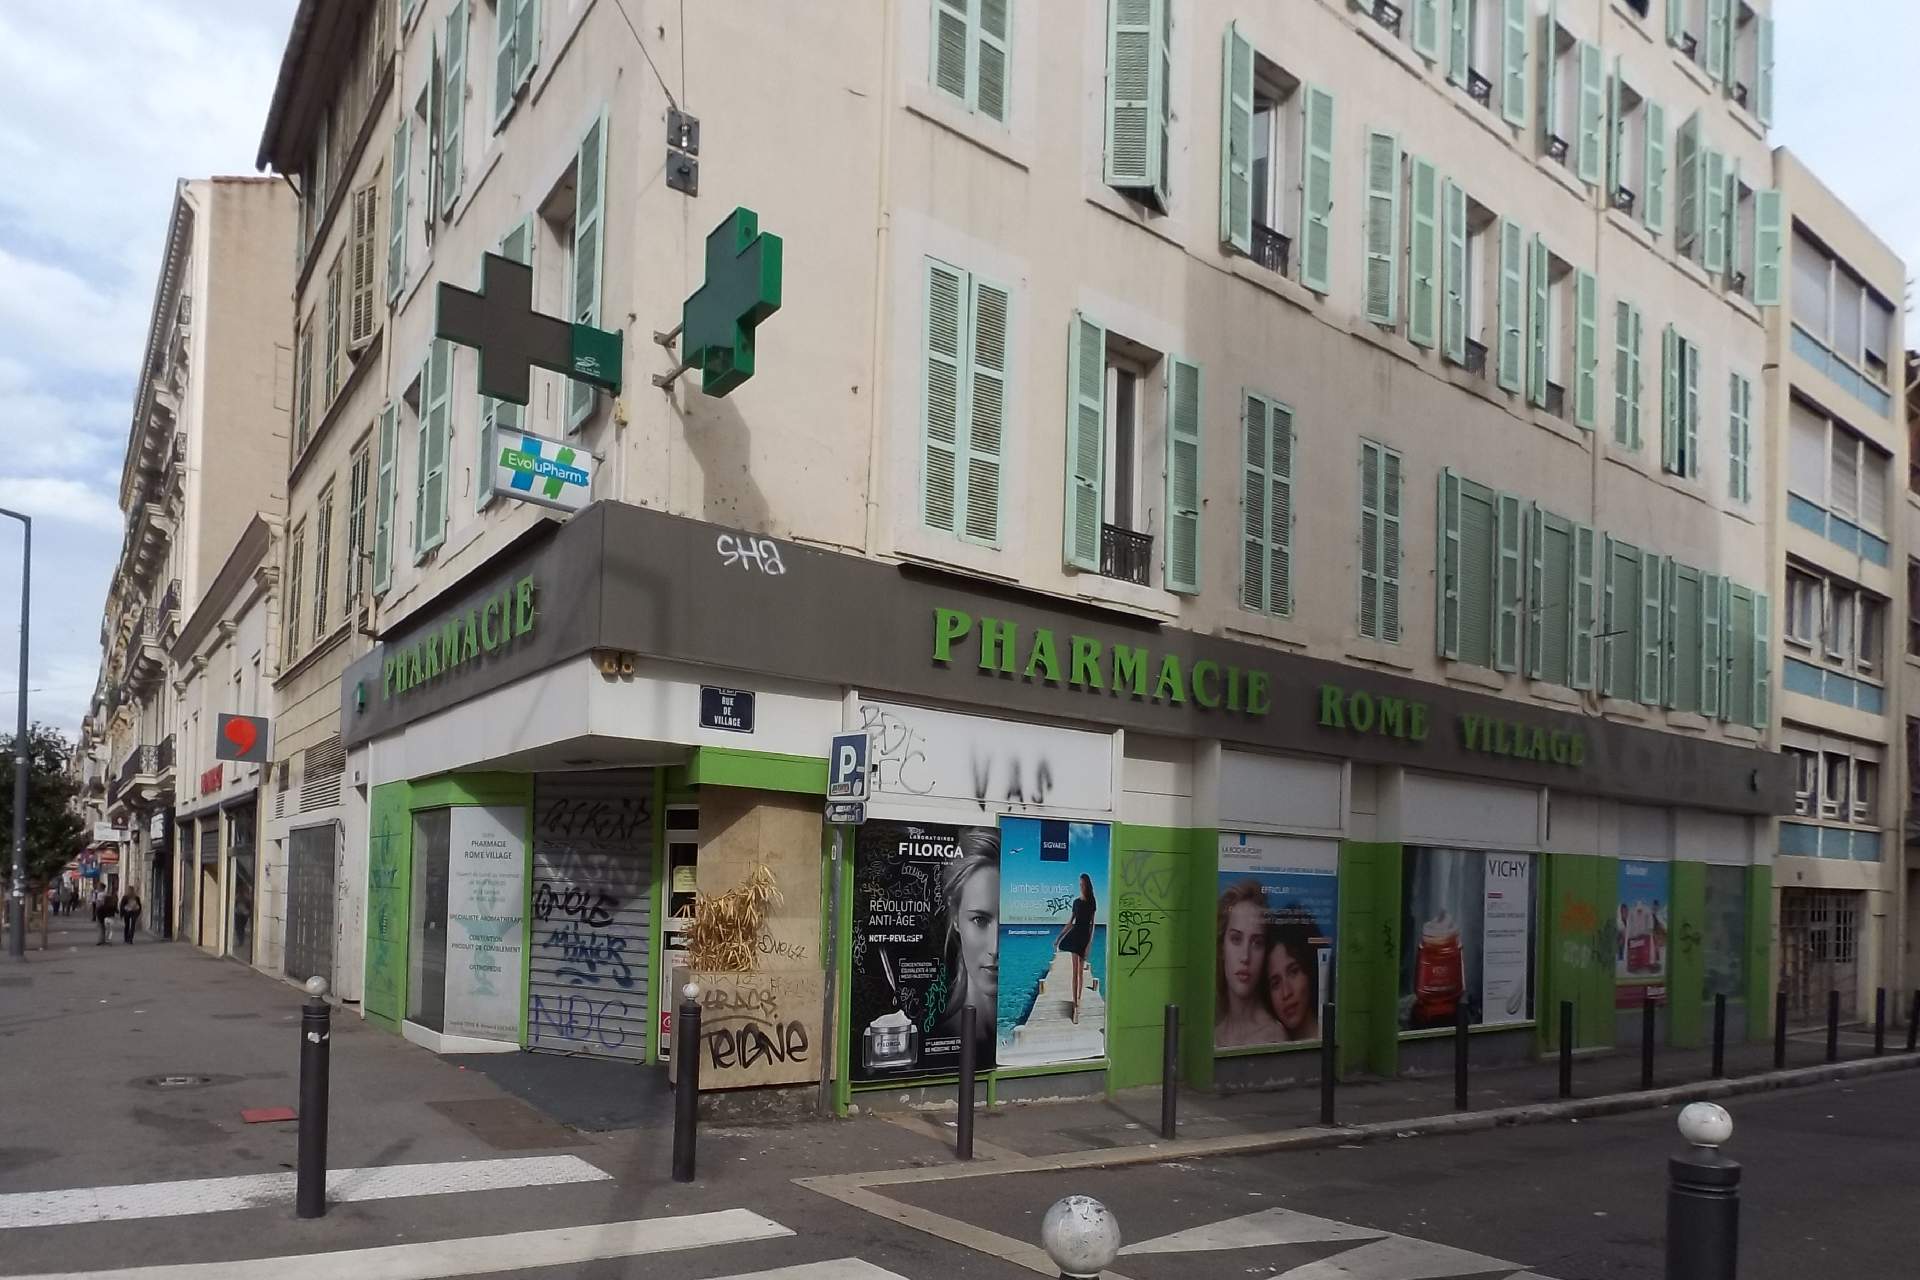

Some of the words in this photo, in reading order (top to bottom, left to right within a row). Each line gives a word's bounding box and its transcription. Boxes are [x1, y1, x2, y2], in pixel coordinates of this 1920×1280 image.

[507, 452, 583, 483] EvoluPharm
[383, 573, 535, 702] PHARMACIE
[932, 608, 1272, 715] PHARMACIE
[1319, 684, 1429, 740] ROME
[1461, 713, 1585, 766] VILLAGE
[721, 695, 735, 706] RUE
[723, 706, 732, 716] DE
[713, 715, 742, 727] VILLAGE
[838, 745, 857, 784] P
[471, 840, 507, 848] PHARMACIE
[898, 842, 964, 859] FILORGA
[464, 851, 485, 859] ROME
[486, 851, 513, 860] VILLAGE
[1488, 859, 1527, 879] VICHY
